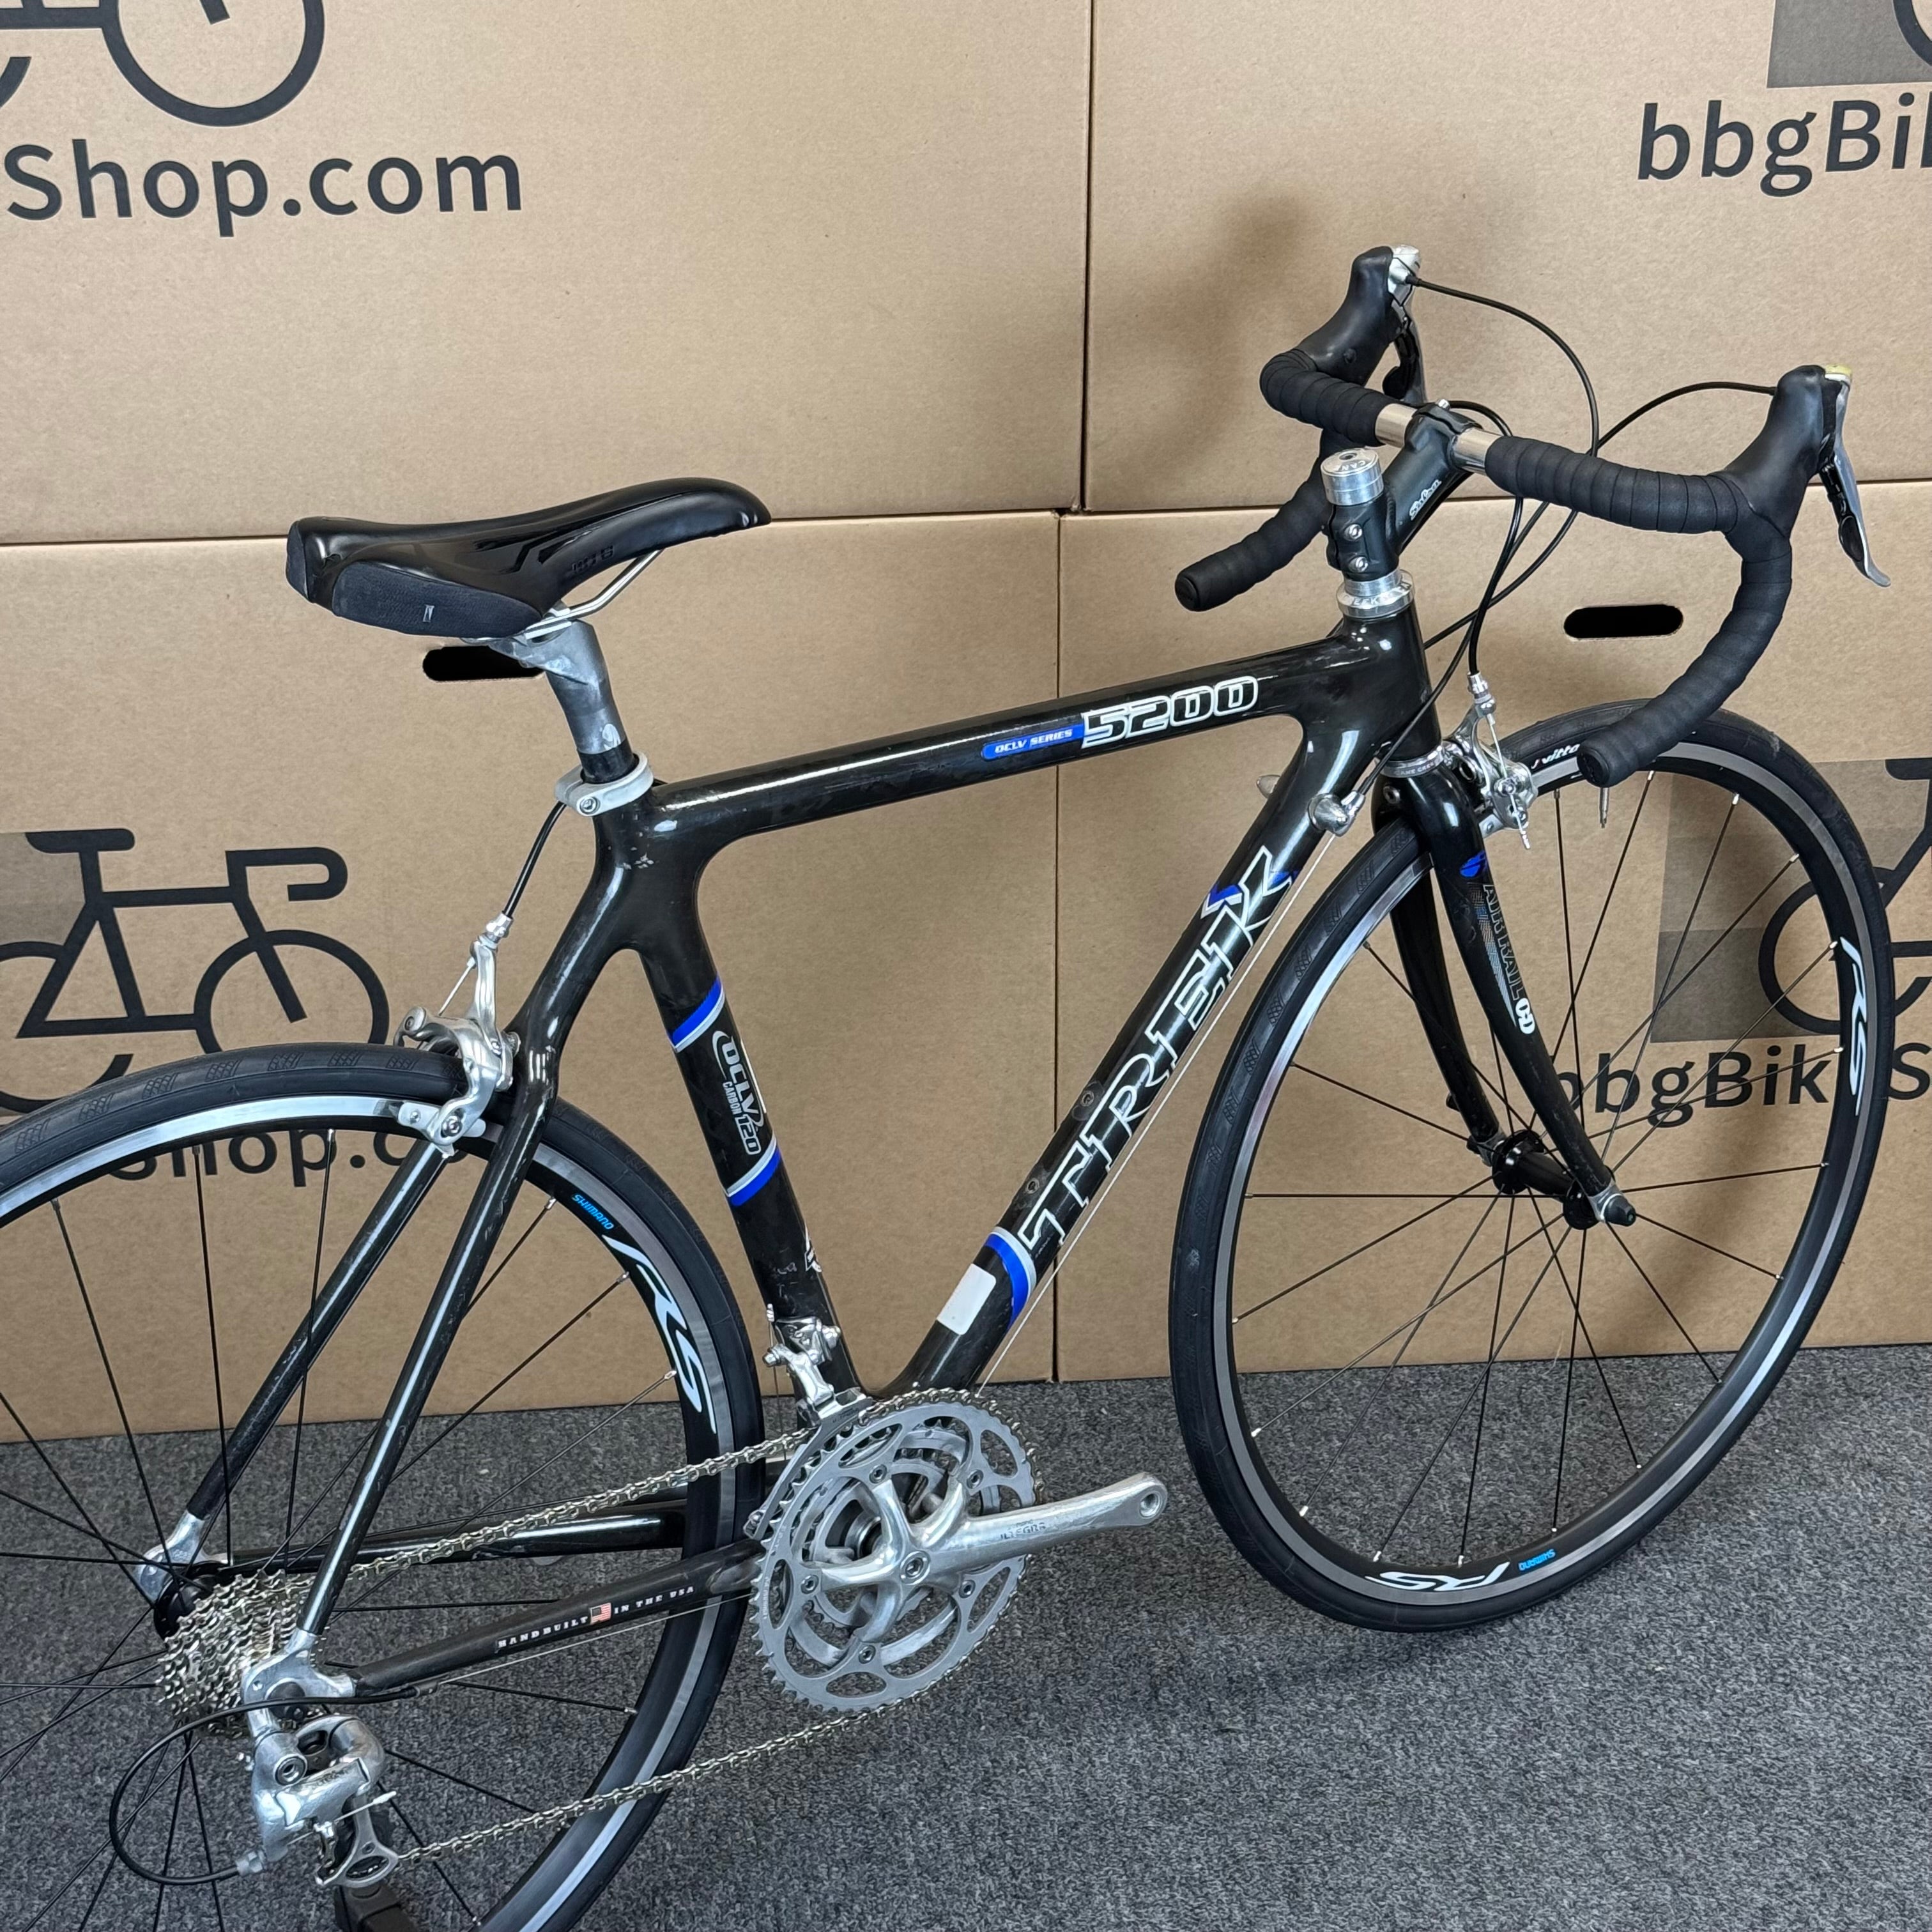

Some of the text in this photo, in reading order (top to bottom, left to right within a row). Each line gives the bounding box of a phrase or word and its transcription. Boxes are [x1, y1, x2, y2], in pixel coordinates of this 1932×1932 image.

[1637, 91, 1932, 197] bbgBi
[4, 139, 522, 237] Shop.com
[994, 676, 1259, 754] OCLV SERIES 5200
[721, 1036, 760, 1114] OCLV
[1017, 845, 1293, 1250] TREK
[723, 1081, 743, 1115] CARBON
[735, 1114, 762, 1155] 120
[572, 1193, 615, 1230] SHIMANO
[614, 1586, 694, 1614] IN THE USA
[498, 1616, 588, 1648] HANDBUILT
